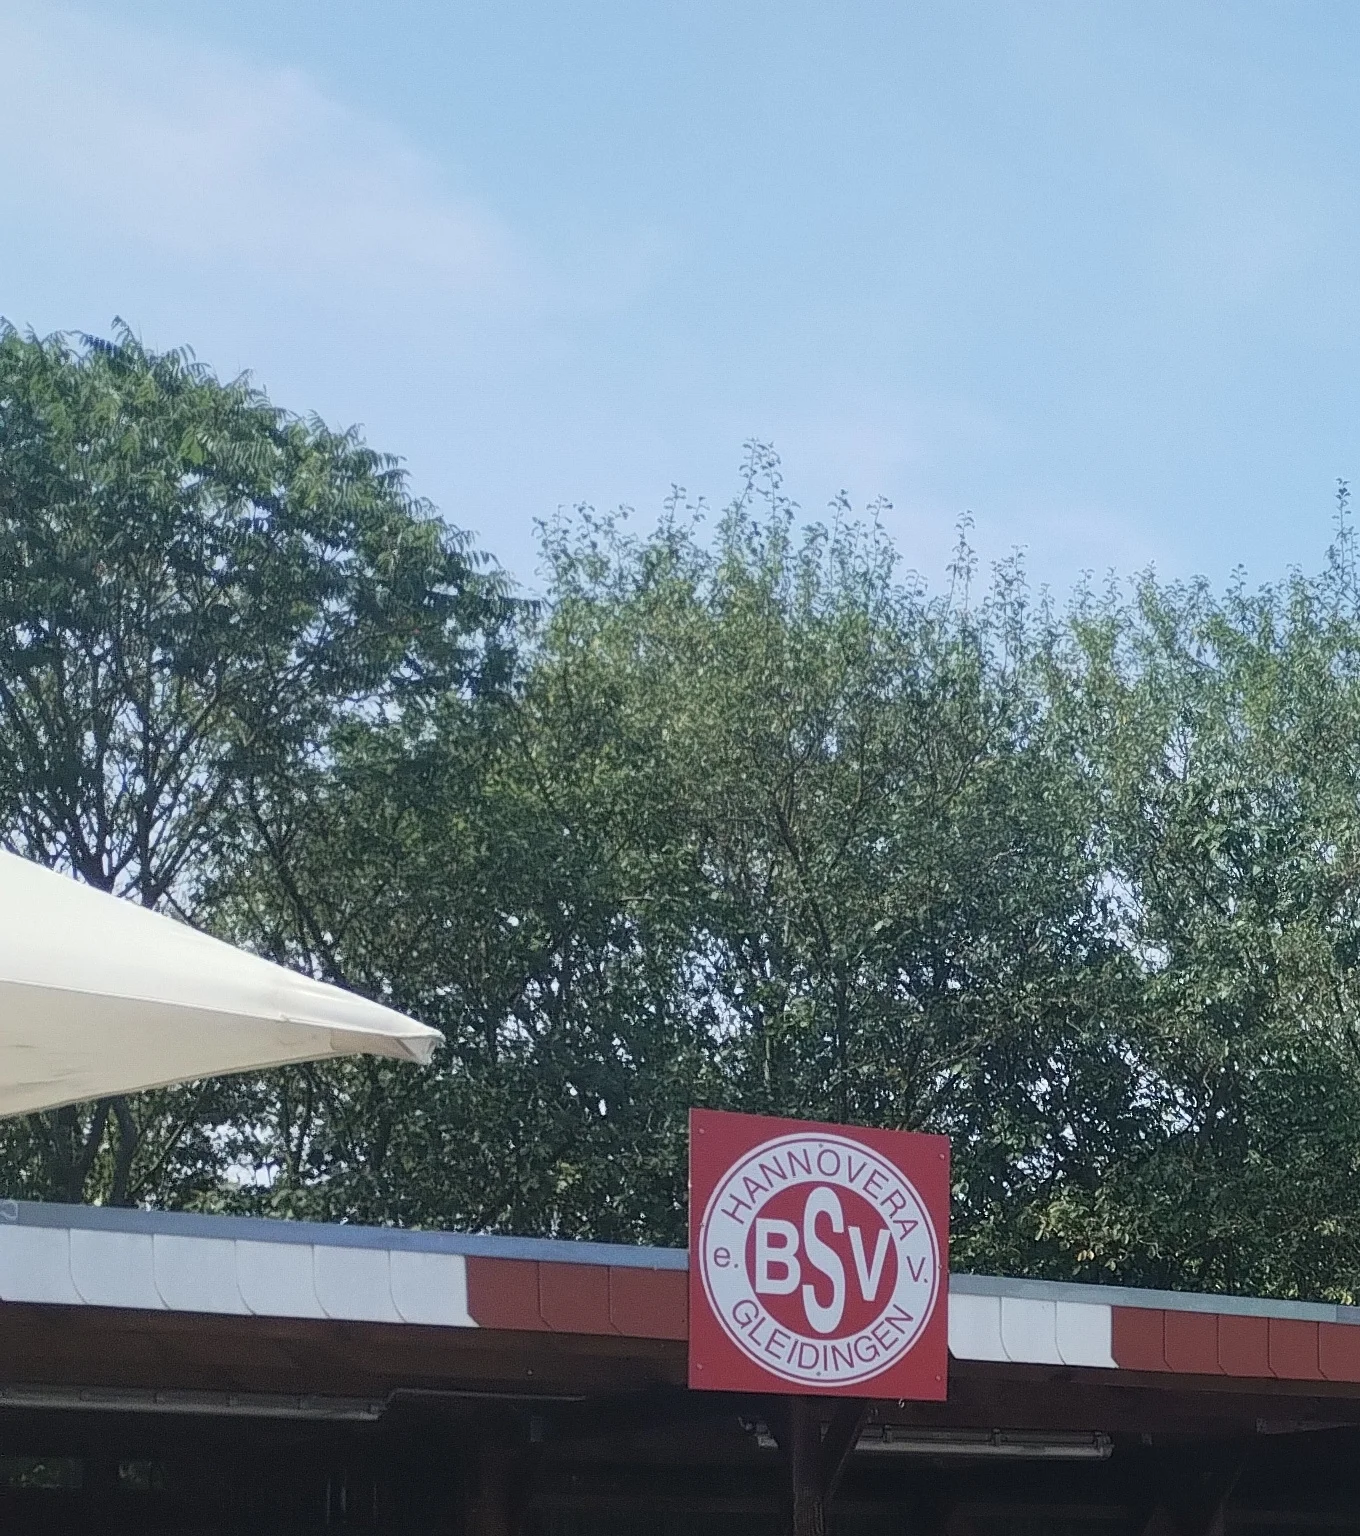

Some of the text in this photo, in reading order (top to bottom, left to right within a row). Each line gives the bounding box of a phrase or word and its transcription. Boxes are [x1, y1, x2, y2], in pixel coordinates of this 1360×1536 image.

[721, 1148, 919, 1242] HANNOVERA
[713, 1246, 929, 1284] e. V.
[754, 1186, 892, 1334] BSV
[731, 1298, 915, 1372] GLEIDINGEN
